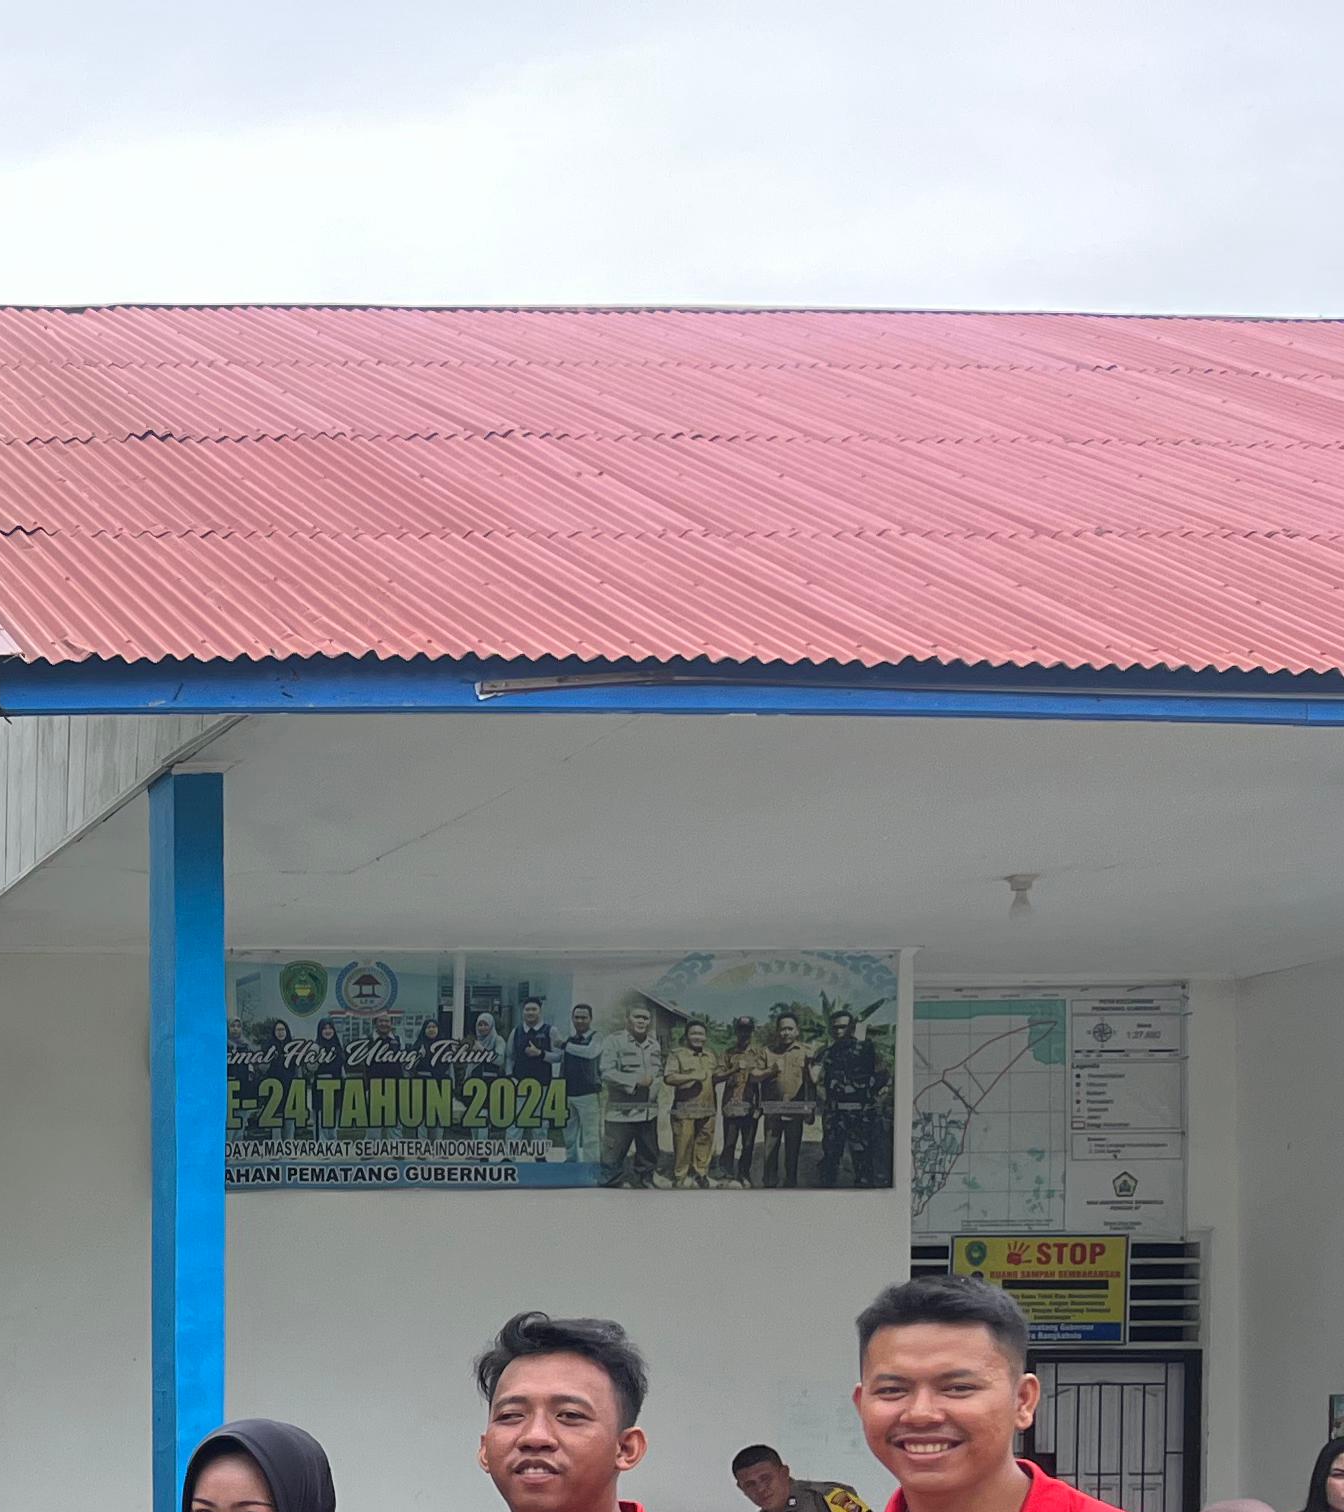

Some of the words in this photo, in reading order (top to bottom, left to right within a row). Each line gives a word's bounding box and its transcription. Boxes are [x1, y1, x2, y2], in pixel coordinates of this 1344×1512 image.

[284, 1040, 337, 1069] Hari
[346, 1039, 420, 1071] Ulang
[431, 1039, 498, 1068] Tahun
[227, 1078, 309, 1128] E-24
[316, 1078, 453, 1129] TAHUN
[462, 1077, 571, 1129] 2024
[225, 1167, 280, 1183] AHAN
[288, 1166, 398, 1183] PEMATANG
[405, 1166, 517, 1183] GUBERNUR
[1037, 1242, 1106, 1265] STOP
